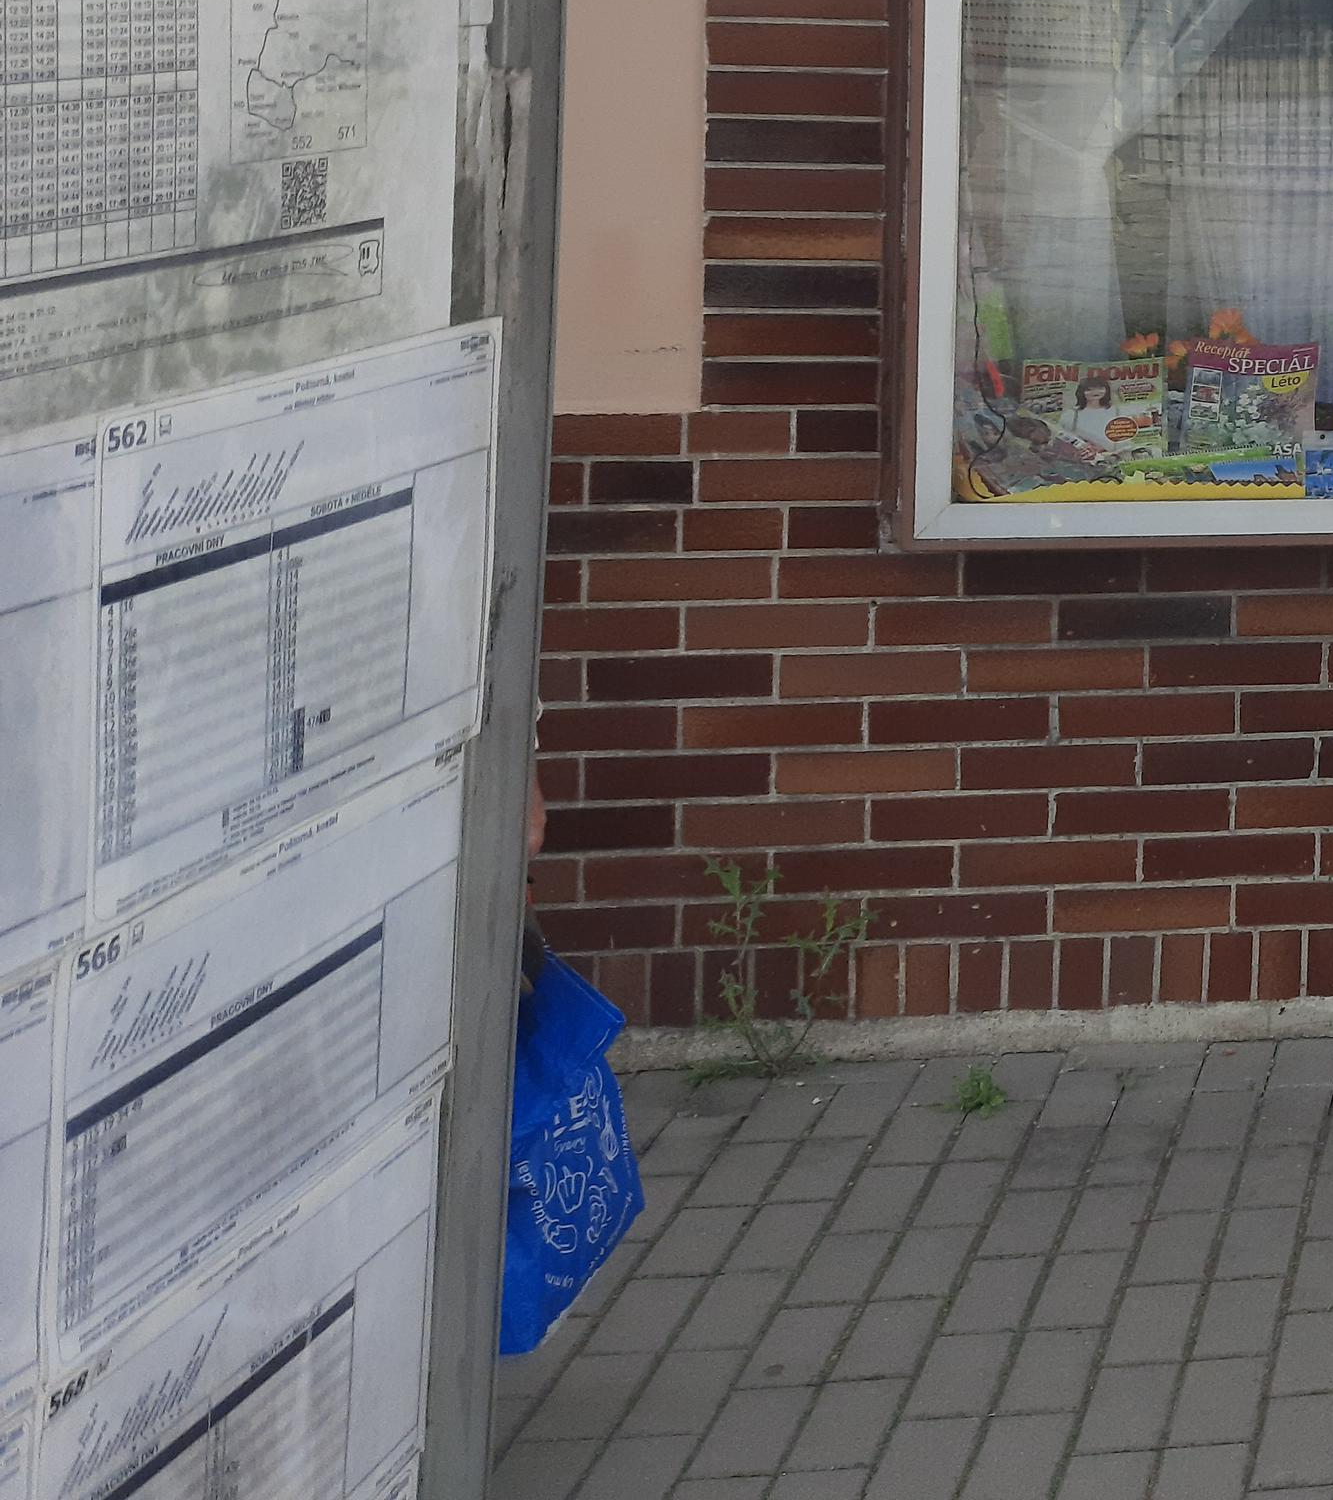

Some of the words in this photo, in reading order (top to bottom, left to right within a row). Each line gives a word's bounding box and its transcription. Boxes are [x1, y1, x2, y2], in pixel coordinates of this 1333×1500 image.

[337, 125, 356, 140] 571
[292, 136, 312, 149] 552
[1195, 341, 1251, 360] Receptář
[1228, 354, 1315, 375] SPECIÁL
[1271, 375, 1301, 389] Léto
[107, 420, 147, 452] 562
[310, 501, 344, 517] SOBOTA
[155, 541, 204, 566] PRACOVNÍ
[205, 535, 225, 551] DNY
[76, 935, 121, 980] 566
